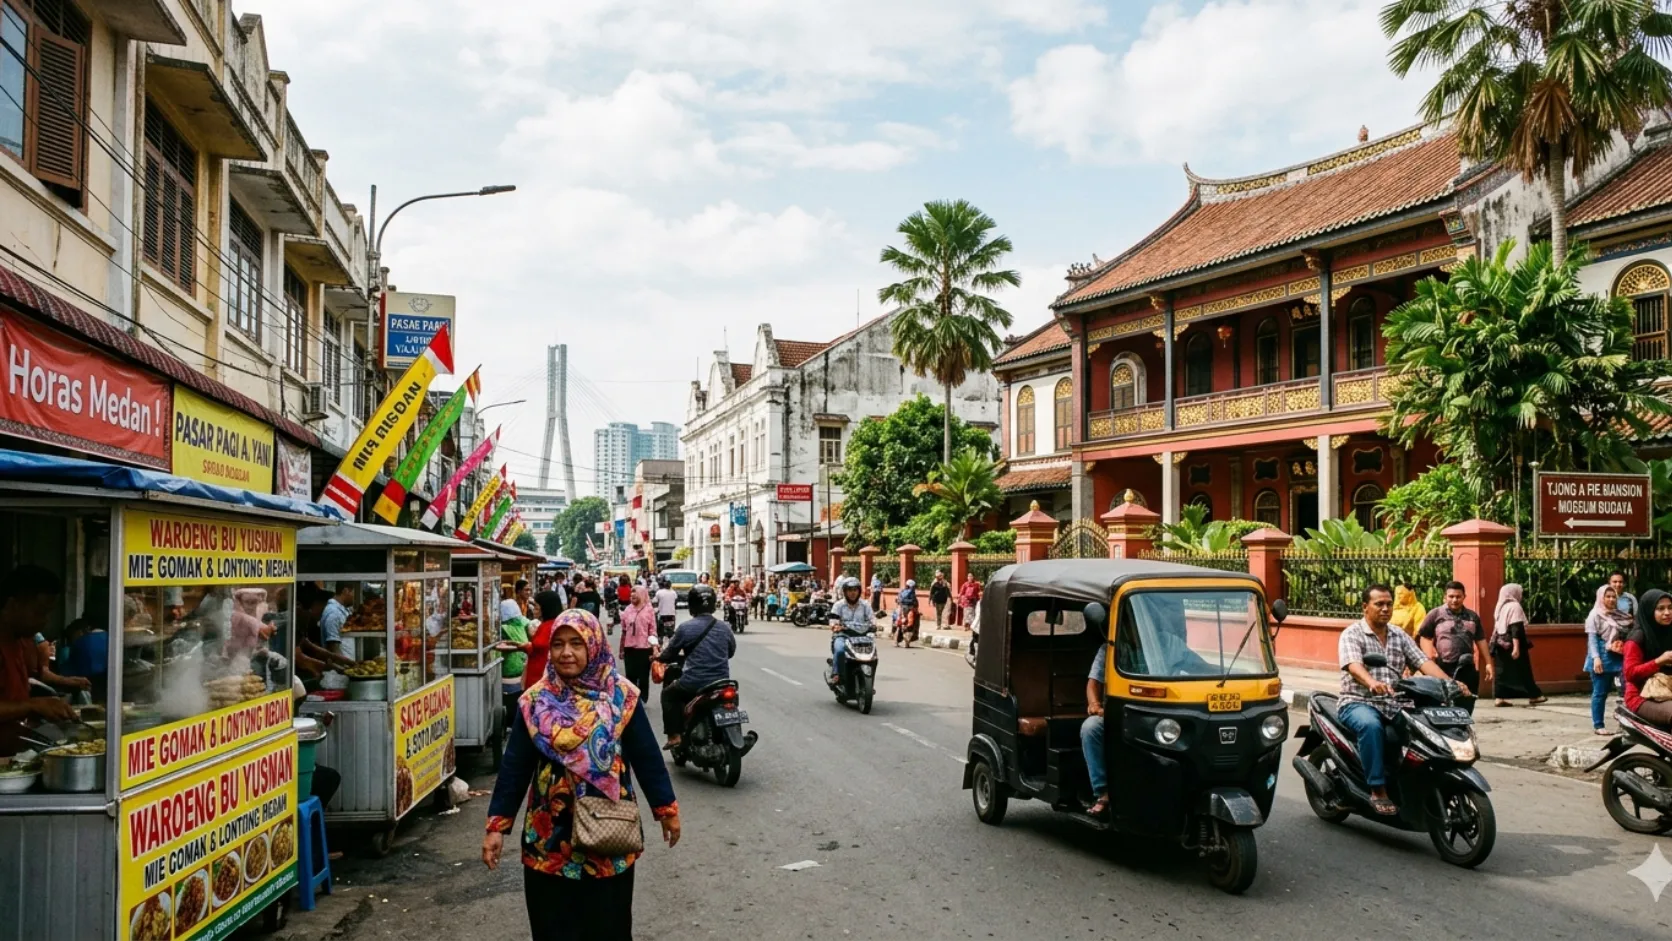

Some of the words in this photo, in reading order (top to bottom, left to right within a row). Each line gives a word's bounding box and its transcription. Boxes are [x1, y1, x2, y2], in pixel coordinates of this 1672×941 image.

[9, 344, 83, 414] Horas
[89, 374, 150, 435] Medan
[155, 399, 161, 437] !
[175, 411, 214, 452] PASAR
[241, 435, 250, 462] A.
[1547, 482, 1577, 496] TJONG
[1579, 483, 1585, 496] A
[150, 519, 218, 551] WAROENG
[221, 526, 237, 552] BU
[128, 555, 154, 579] MIE
[157, 556, 203, 578] GOMAK
[217, 558, 262, 578] LONTONG
[128, 737, 155, 777] MIE
[159, 721, 206, 766] GOMAK
[220, 705, 262, 744] LONTONG
[130, 780, 216, 859] WAROENG
[220, 769, 239, 816] BU
[144, 856, 166, 888] MIE
